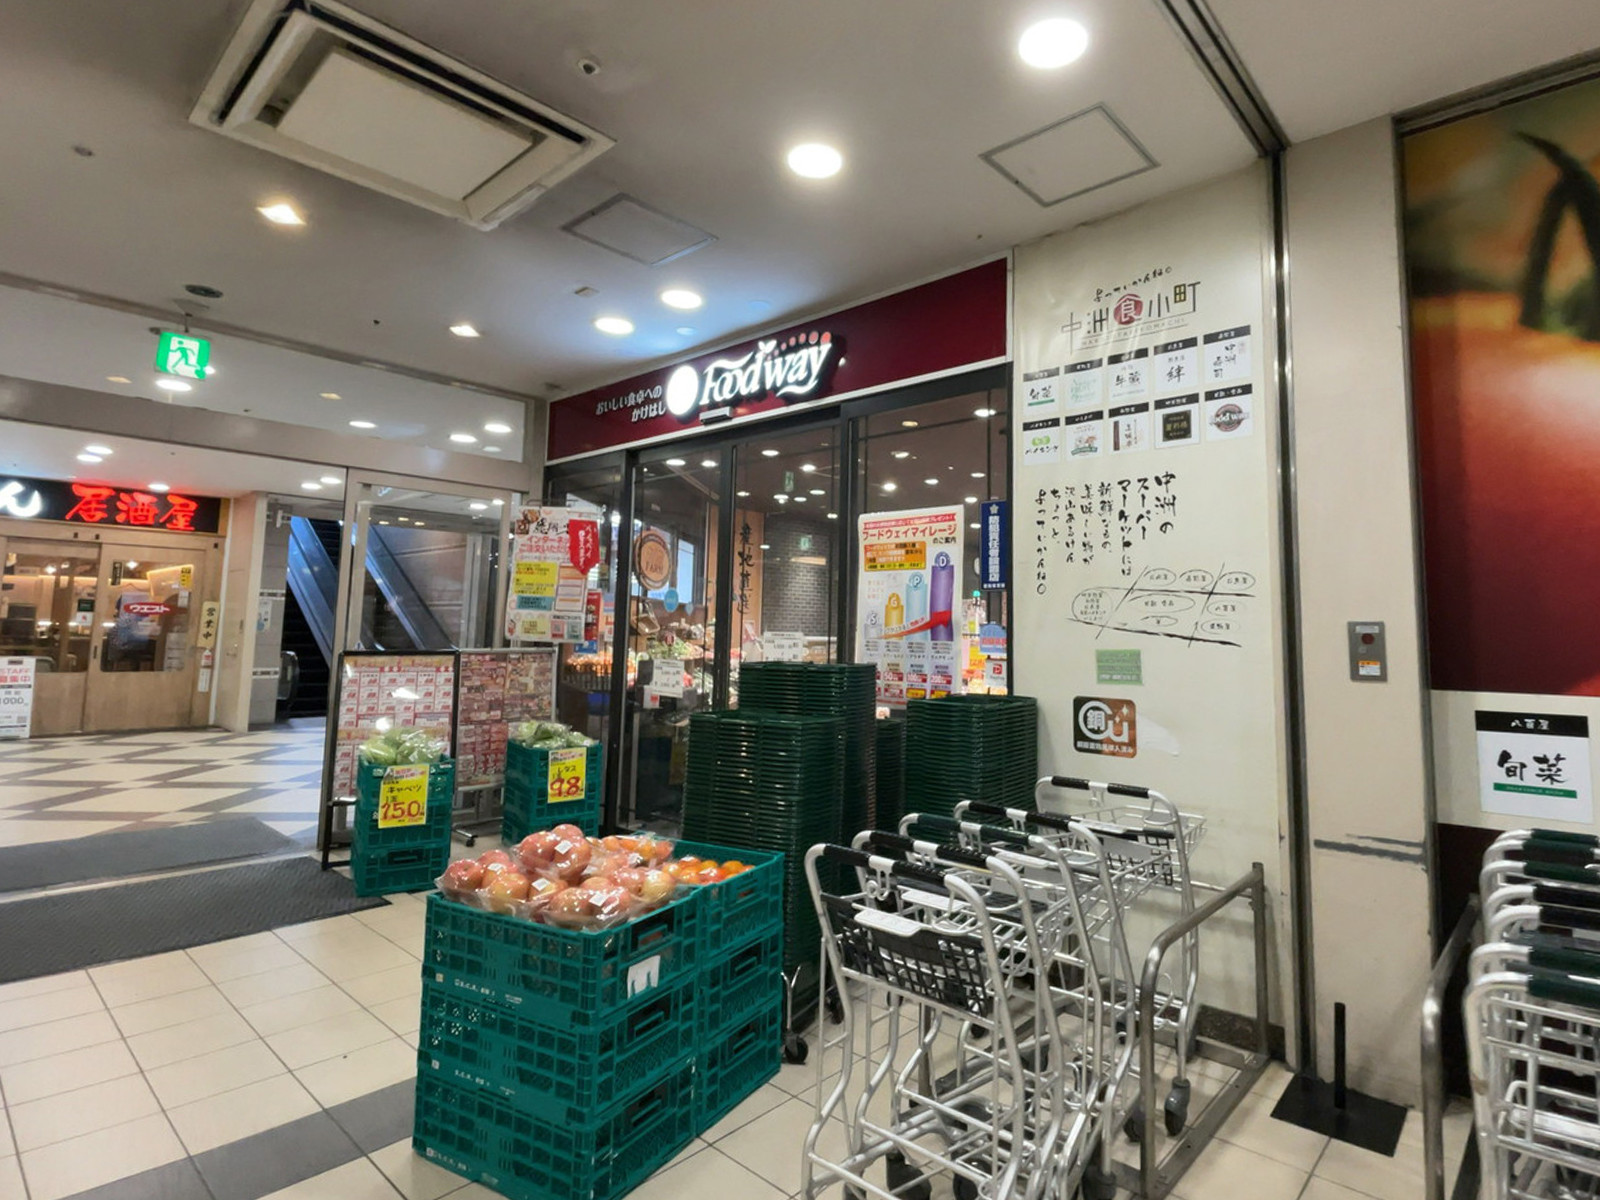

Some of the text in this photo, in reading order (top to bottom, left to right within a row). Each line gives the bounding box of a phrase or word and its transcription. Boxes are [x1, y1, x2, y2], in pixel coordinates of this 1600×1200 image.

[699, 340, 833, 405] Foodway
[595, 384, 663, 416] おいしい食卓への
[631, 401, 667, 422] かけはし
[65, 483, 200, 531] 居酒屋
[1136, 477, 1151, 541] スーパー
[1154, 471, 1177, 535] 中洲の
[862, 523, 957, 542] フードウェイマイレージ
[1510, 718, 1550, 730] 八百屋
[1497, 749, 1567, 785] 旬菜
[550, 775, 581, 797] 98
[380, 800, 422, 820] 150
